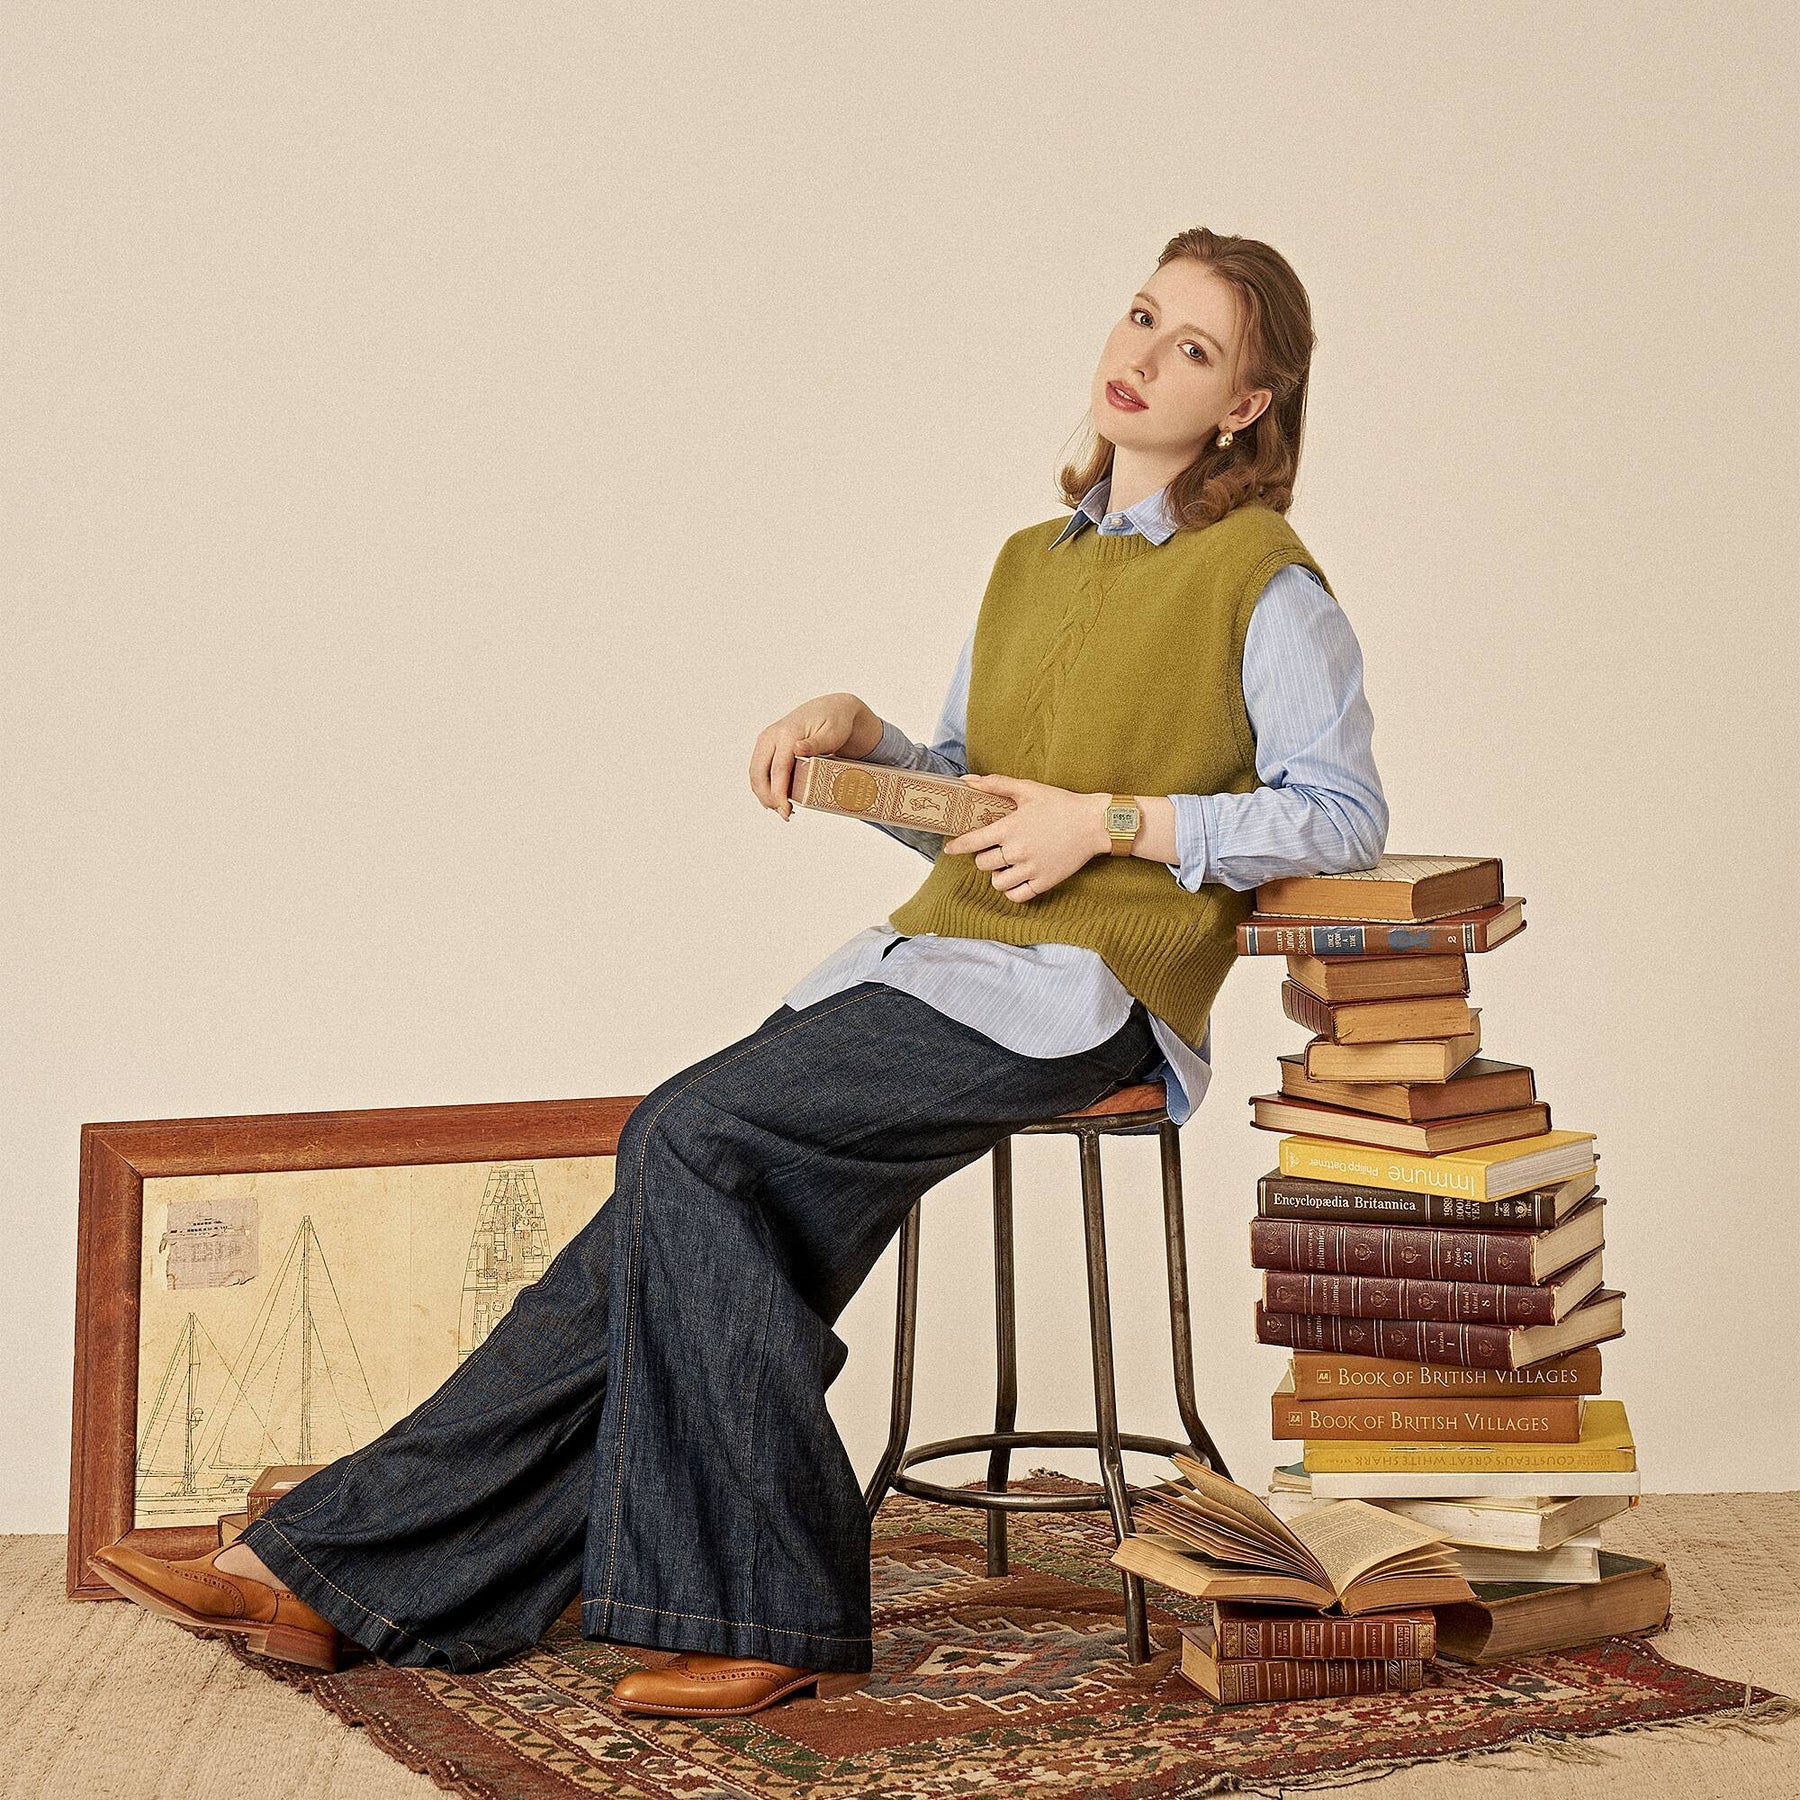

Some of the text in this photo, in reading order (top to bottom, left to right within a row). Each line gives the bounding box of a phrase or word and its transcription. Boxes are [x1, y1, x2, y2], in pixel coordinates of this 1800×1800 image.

[1285, 930, 1295, 952] Junior
[1296, 926, 1308, 954] Classics
[1447, 935, 1457, 944] 2
[1348, 1161, 1379, 1177] Philipp
[1387, 1165, 1475, 1197] Immune
[1273, 1192, 1417, 1212] Encyclopædia Britannica
[1443, 1198, 1453, 1216] 1989
[1316, 1228, 1325, 1269] Britannica
[1463, 1252, 1472, 1265] 23
[1339, 1368, 1391, 1387] BOOK
[1393, 1372, 1413, 1384] OF
[1420, 1367, 1486, 1387] BRITISH
[1496, 1369, 1578, 1384] VILLAGES
[1310, 1411, 1362, 1431] BOOK
[1364, 1416, 1384, 1429] OF
[1391, 1412, 1457, 1432] BRITISH
[1464, 1413, 1549, 1431] VILLAGES
[1355, 1456, 1399, 1466] SHARK
[1402, 1456, 1446, 1466] WHITE
[1449, 1455, 1492, 1466] GREAT
[1496, 1455, 1574, 1466] COUSTEAU'S
